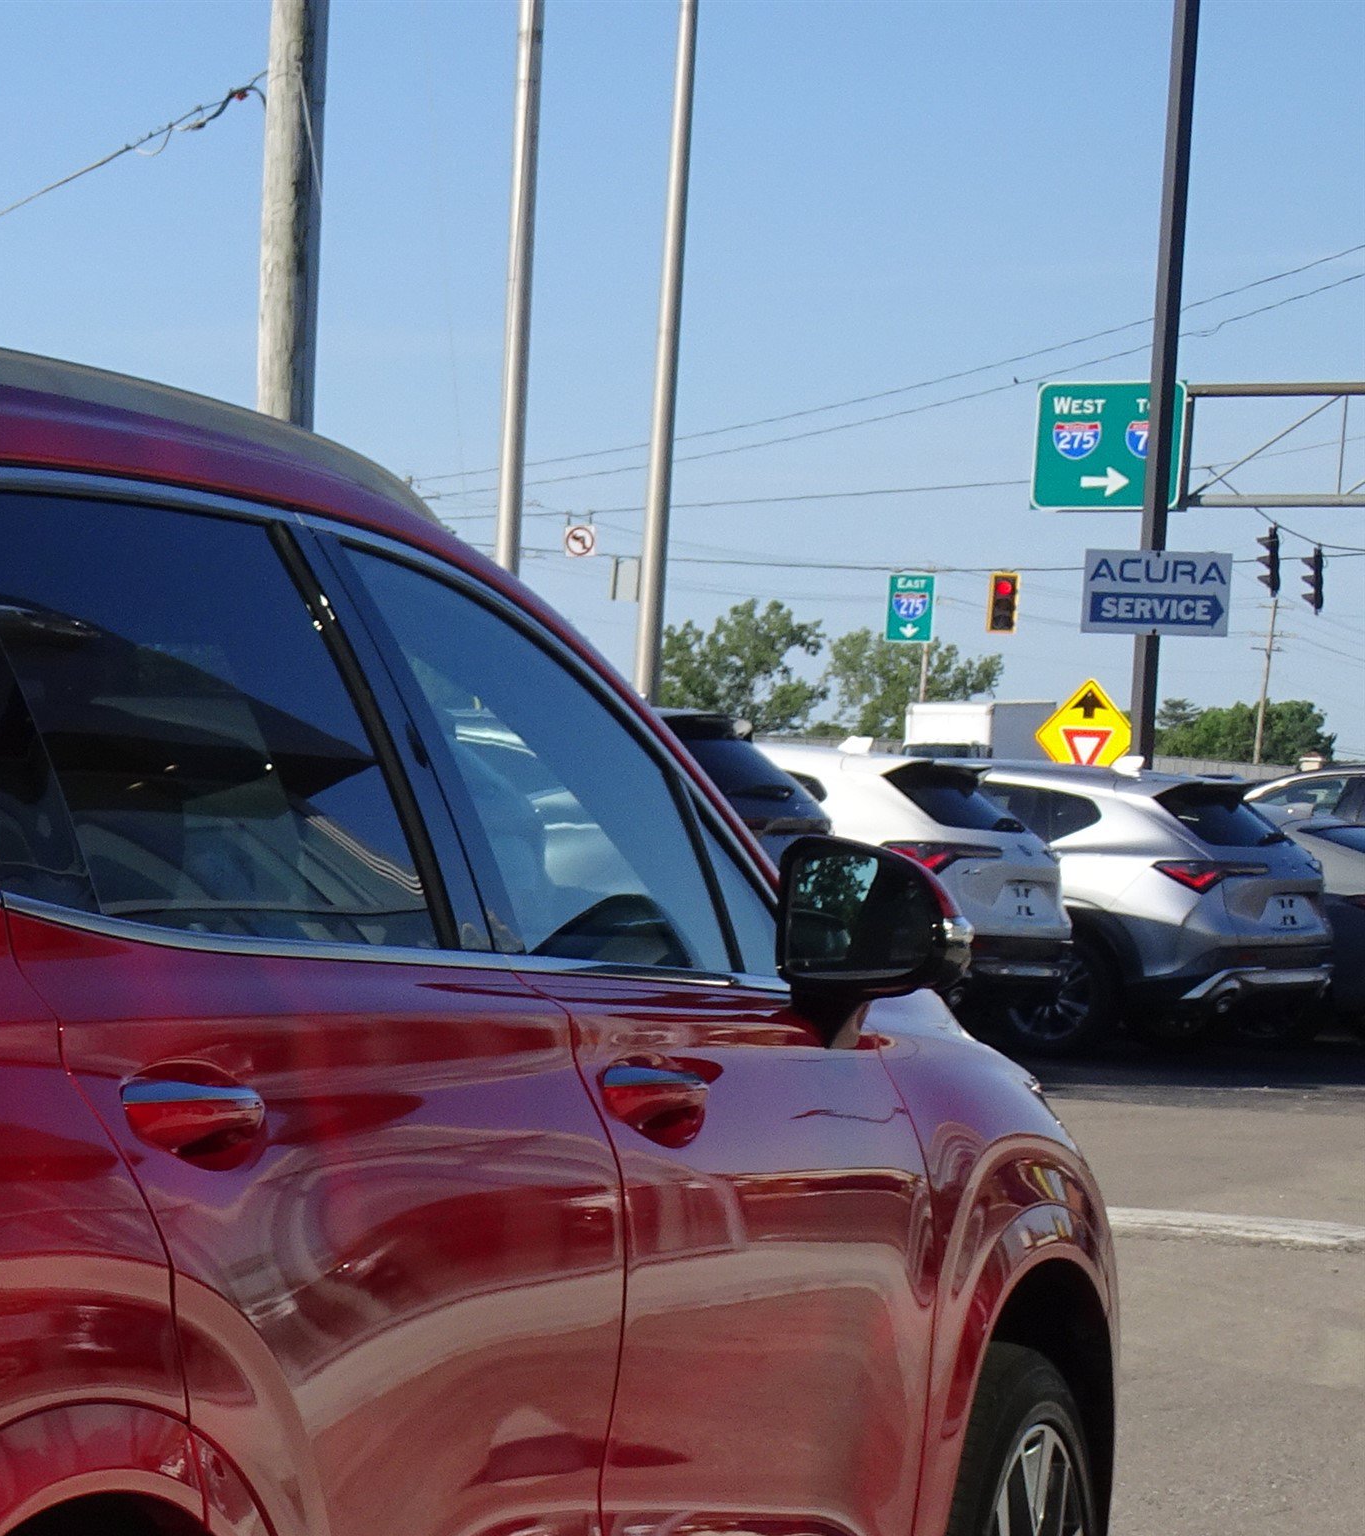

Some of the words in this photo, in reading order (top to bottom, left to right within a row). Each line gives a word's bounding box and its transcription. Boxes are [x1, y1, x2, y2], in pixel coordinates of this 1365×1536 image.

[1053, 396, 1106, 415] WEST
[1136, 398, 1150, 414] T
[1057, 430, 1095, 449] 275
[1089, 557, 1227, 585] ACURA
[901, 600, 923, 615] 275
[1100, 597, 1213, 622] SERVICE
